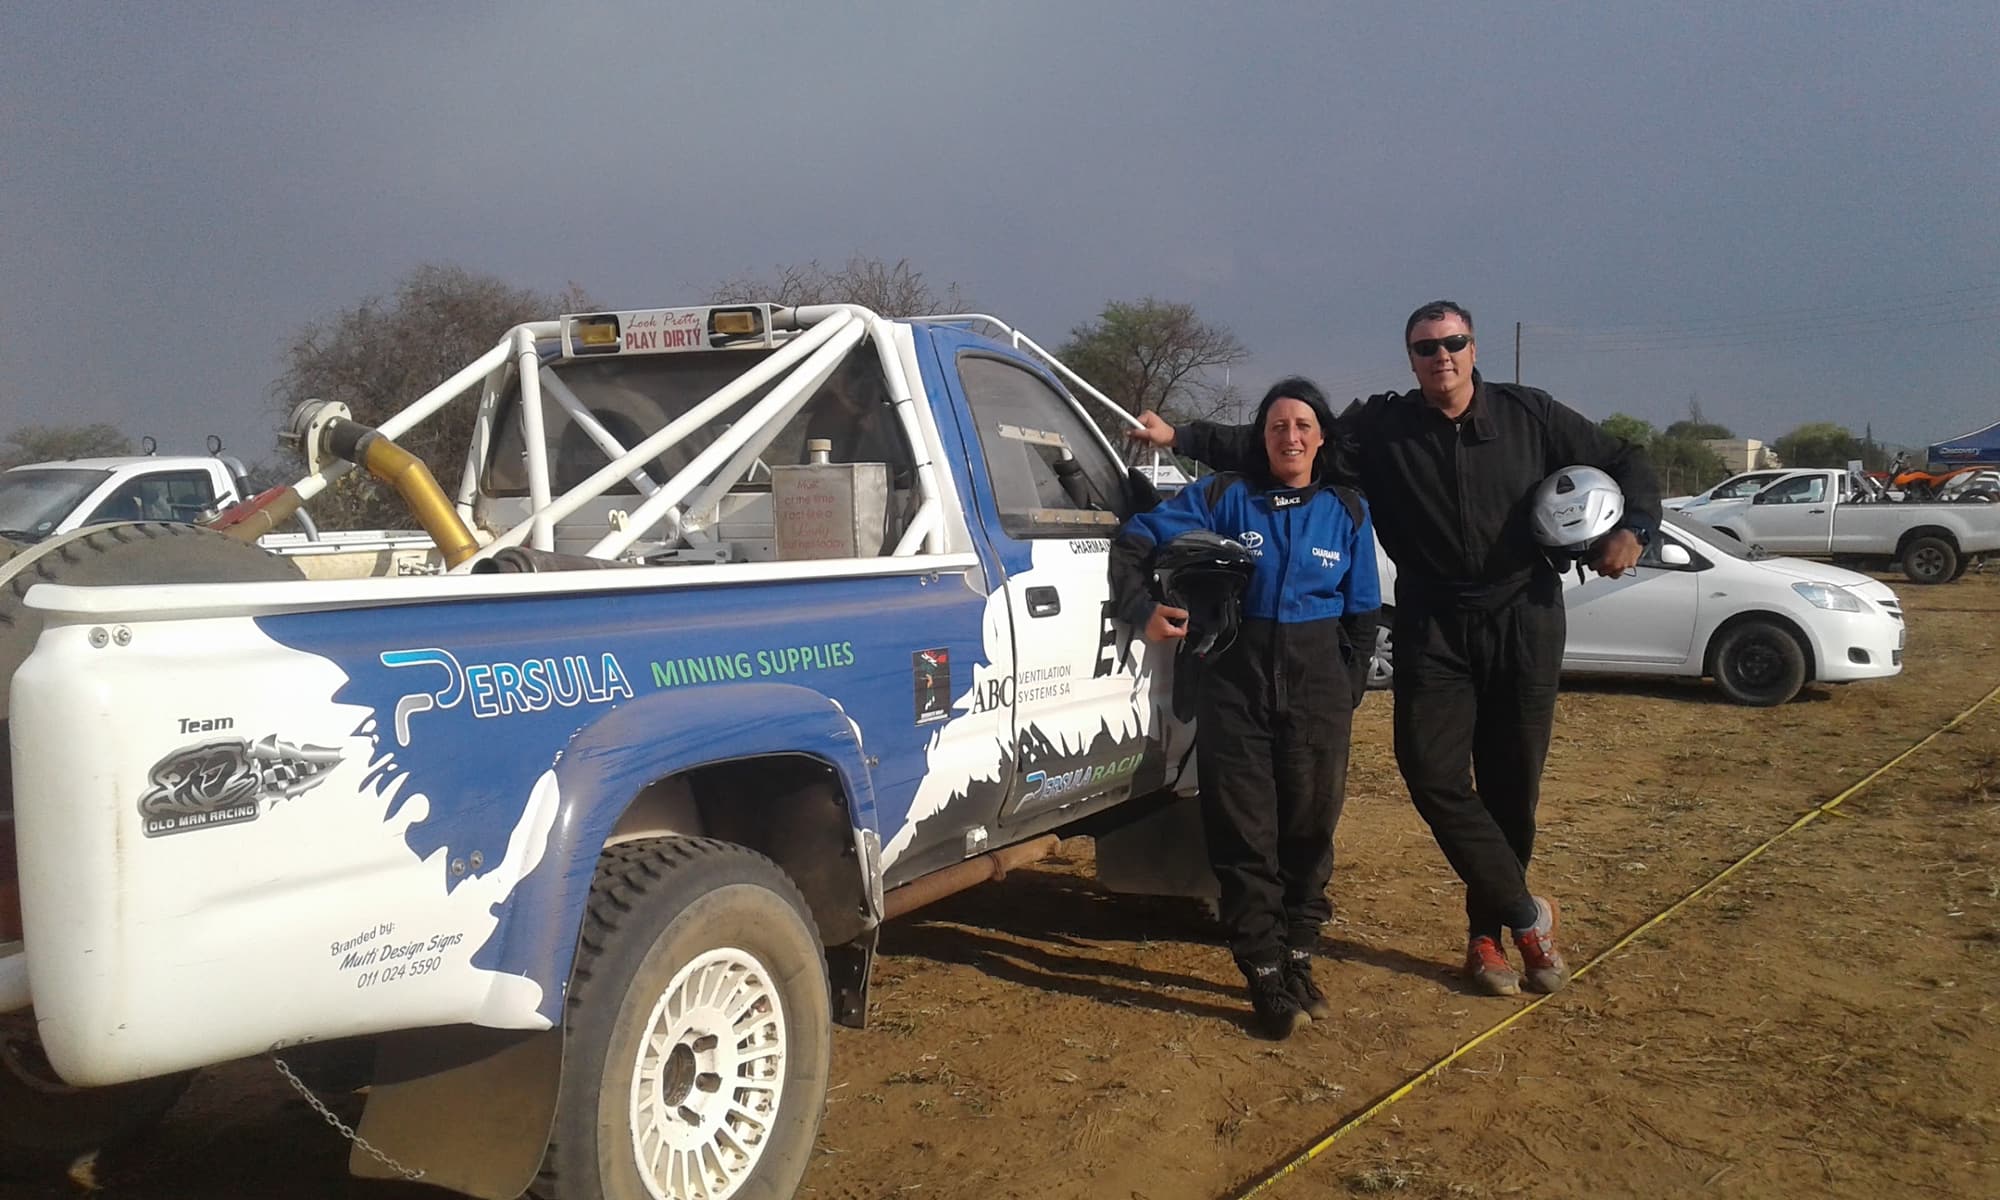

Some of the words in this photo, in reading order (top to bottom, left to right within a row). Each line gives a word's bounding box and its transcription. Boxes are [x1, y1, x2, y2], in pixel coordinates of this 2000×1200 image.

[627, 314, 656, 329] Look
[664, 312, 700, 328] Pretty
[626, 331, 657, 350] PLAY
[663, 329, 701, 348] DIRTY
[380, 648, 633, 746] PERSULA
[650, 652, 753, 688] MINING
[757, 642, 855, 676] SUPPLIES
[972, 675, 1014, 714] ABC
[1018, 664, 1071, 684] VENTILATION
[1018, 684, 1057, 703] SYSTEMS
[1059, 682, 1071, 695] SA
[178, 717, 234, 734] Team
[149, 819, 175, 831] OLD
[178, 813, 206, 827] MAN
[209, 805, 254, 822] RACING
[330, 925, 377, 957] Branded
[379, 921, 396, 936] by:
[339, 947, 380, 970] Multi
[379, 941, 425, 961] Design
[426, 932, 464, 952] Signs
[357, 970, 380, 989] 011
[381, 963, 407, 983] 024
[409, 956, 442, 977] 5590
